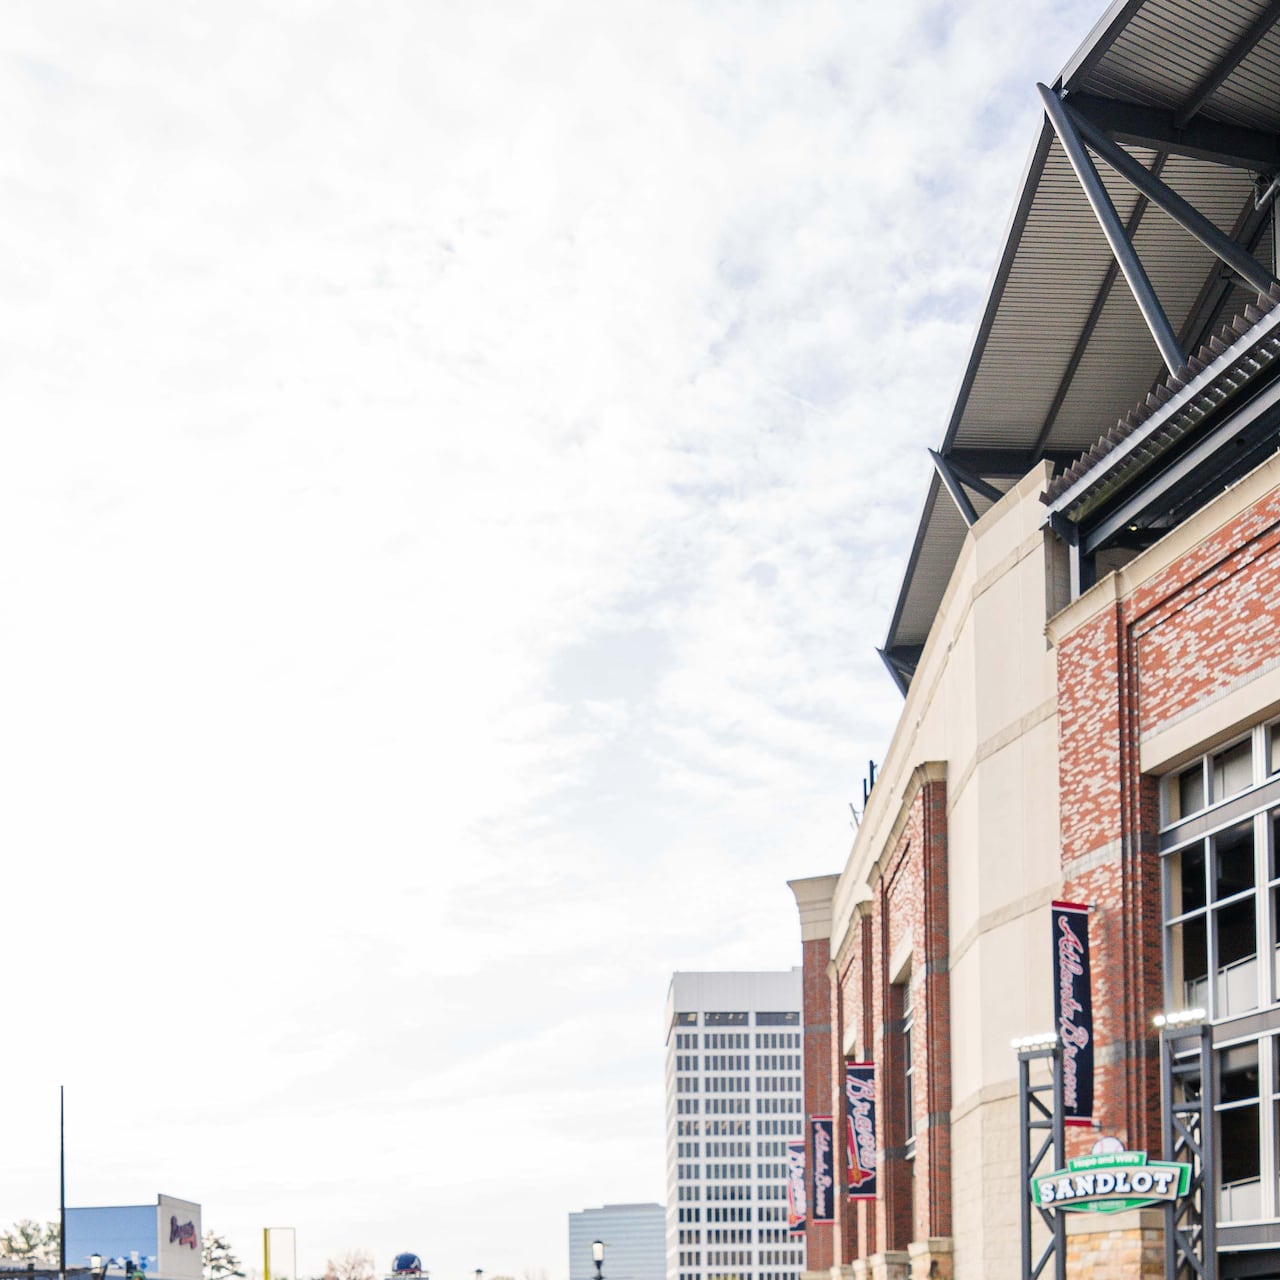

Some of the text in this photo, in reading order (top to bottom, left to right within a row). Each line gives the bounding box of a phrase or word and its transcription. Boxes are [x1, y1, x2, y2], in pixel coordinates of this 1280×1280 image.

[1059, 915, 1089, 1112] Atlanta Braves
[847, 1075, 876, 1169] Braves
[1039, 1171, 1173, 1203] SANDLOT
